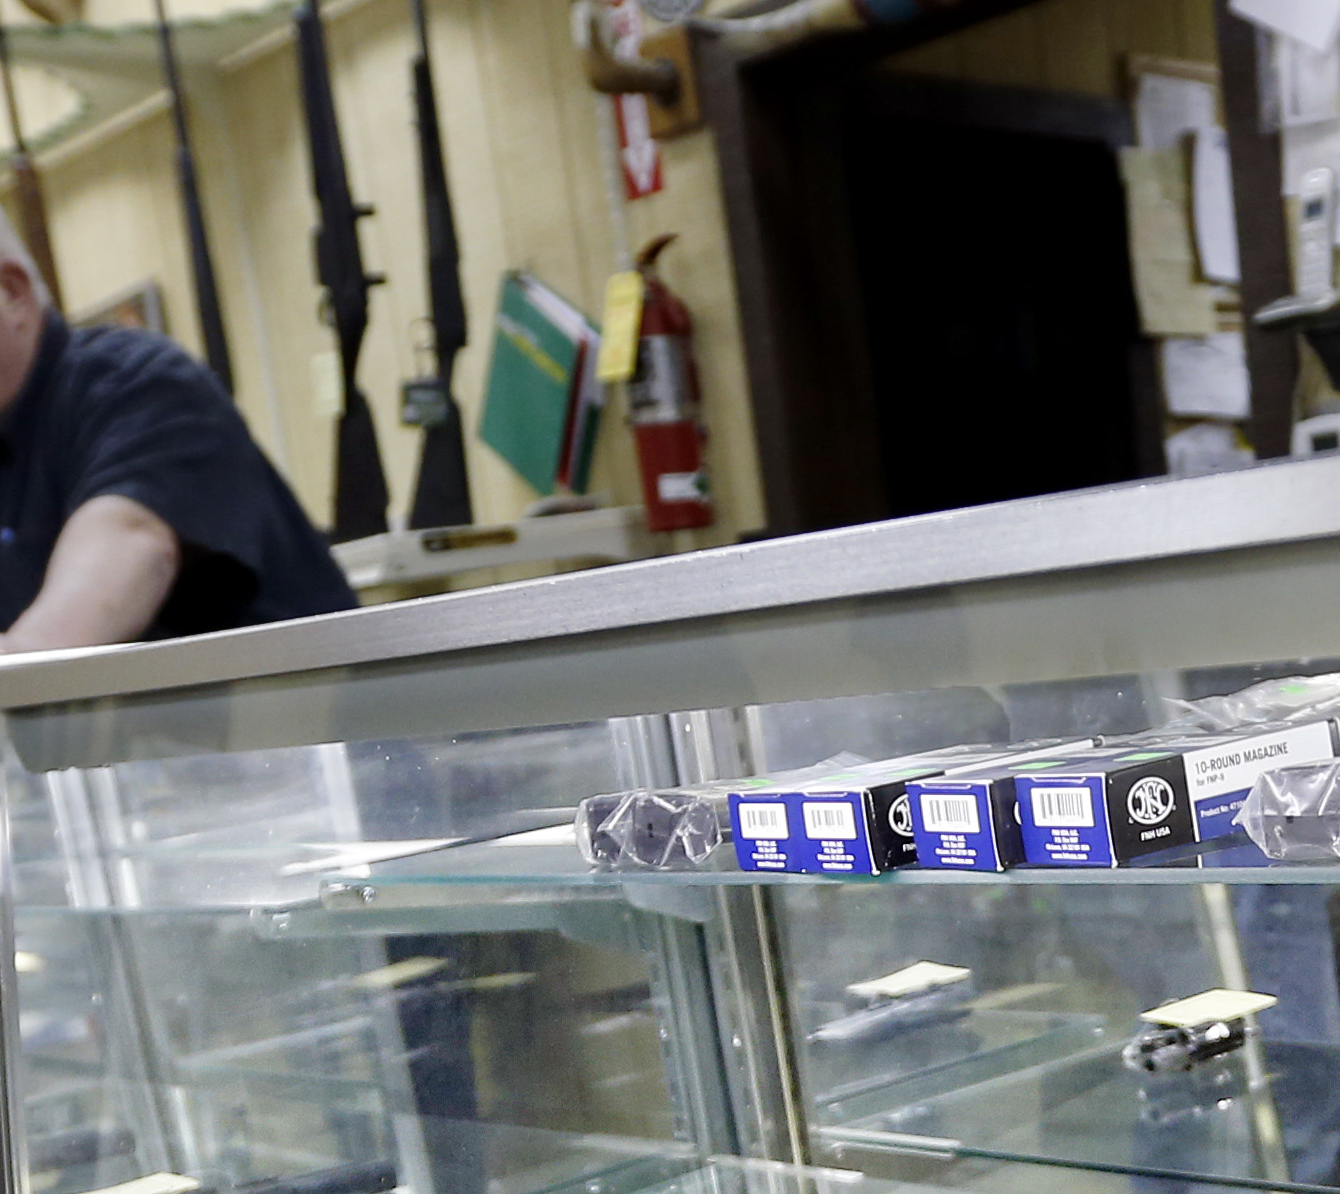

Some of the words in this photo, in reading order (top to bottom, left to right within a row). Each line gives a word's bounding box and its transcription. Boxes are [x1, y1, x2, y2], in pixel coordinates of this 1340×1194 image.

[1195, 753, 1241, 774] 10-ROUND
[1243, 742, 1289, 760] MAGAZINE
[1156, 825, 1172, 839] USA
